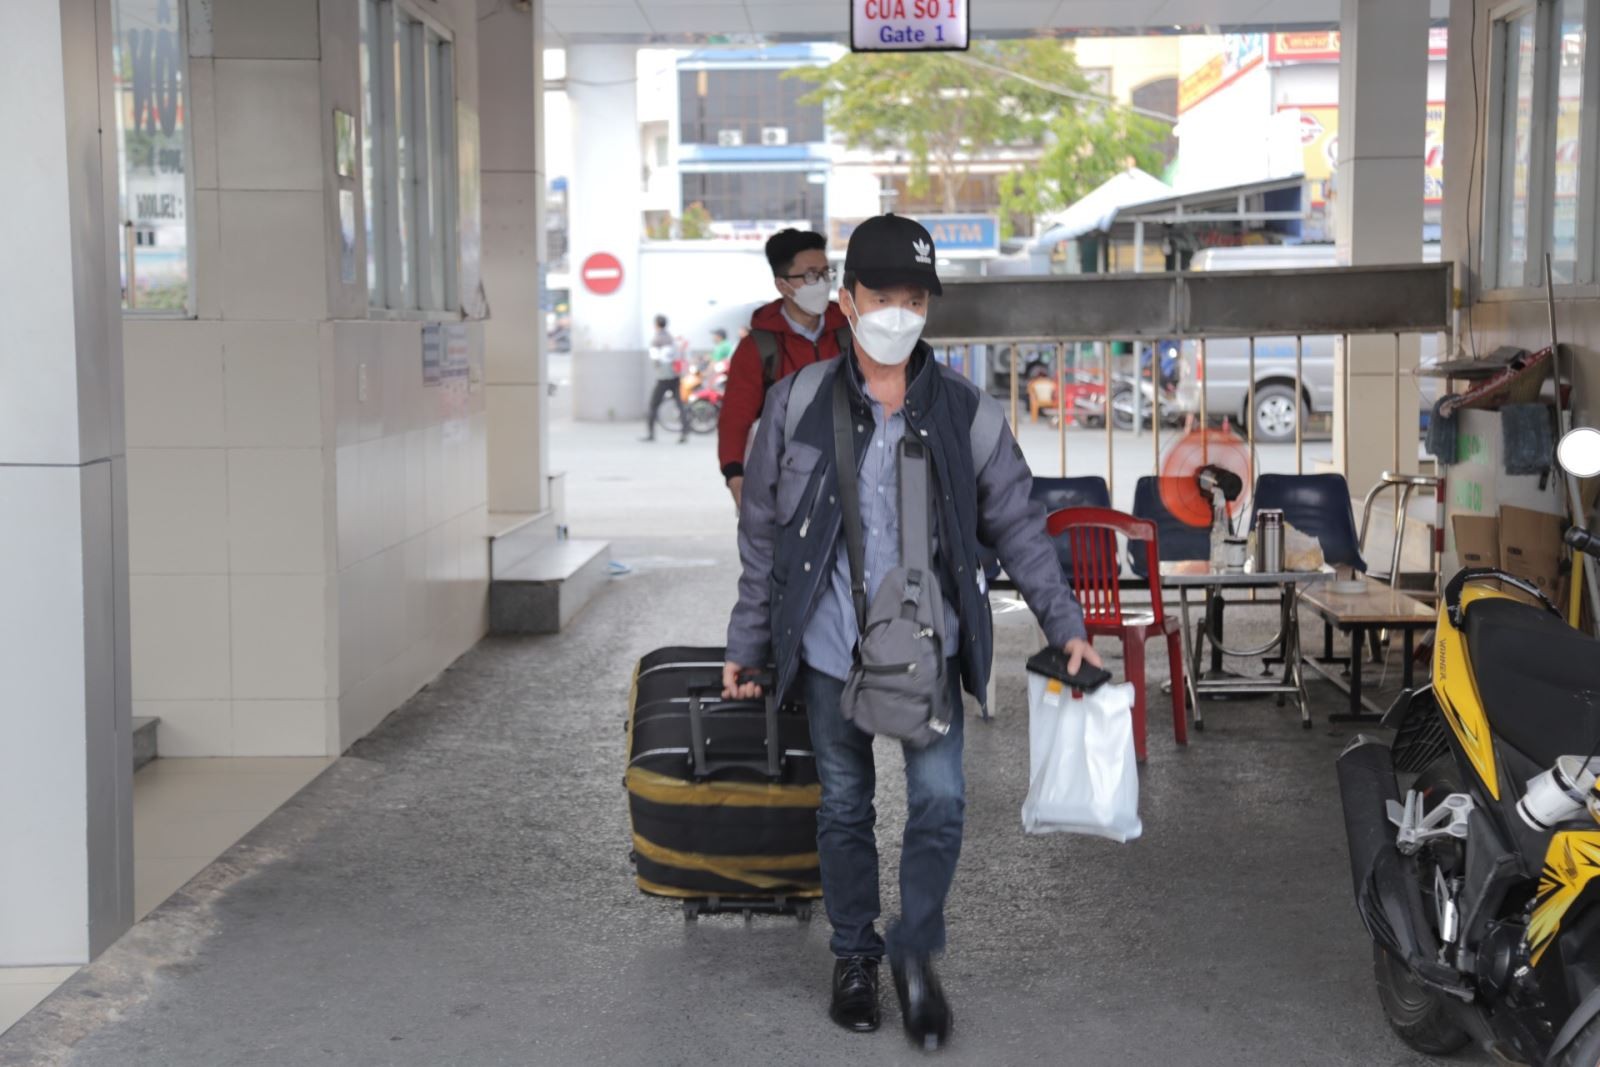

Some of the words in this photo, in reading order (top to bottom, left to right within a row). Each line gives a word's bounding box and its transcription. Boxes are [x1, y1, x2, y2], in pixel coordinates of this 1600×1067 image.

[879, 25, 925, 43] Gate
[935, 25, 944, 42] 1
[932, 223, 982, 242] ATM
[1439, 639, 1448, 683] WINNER
